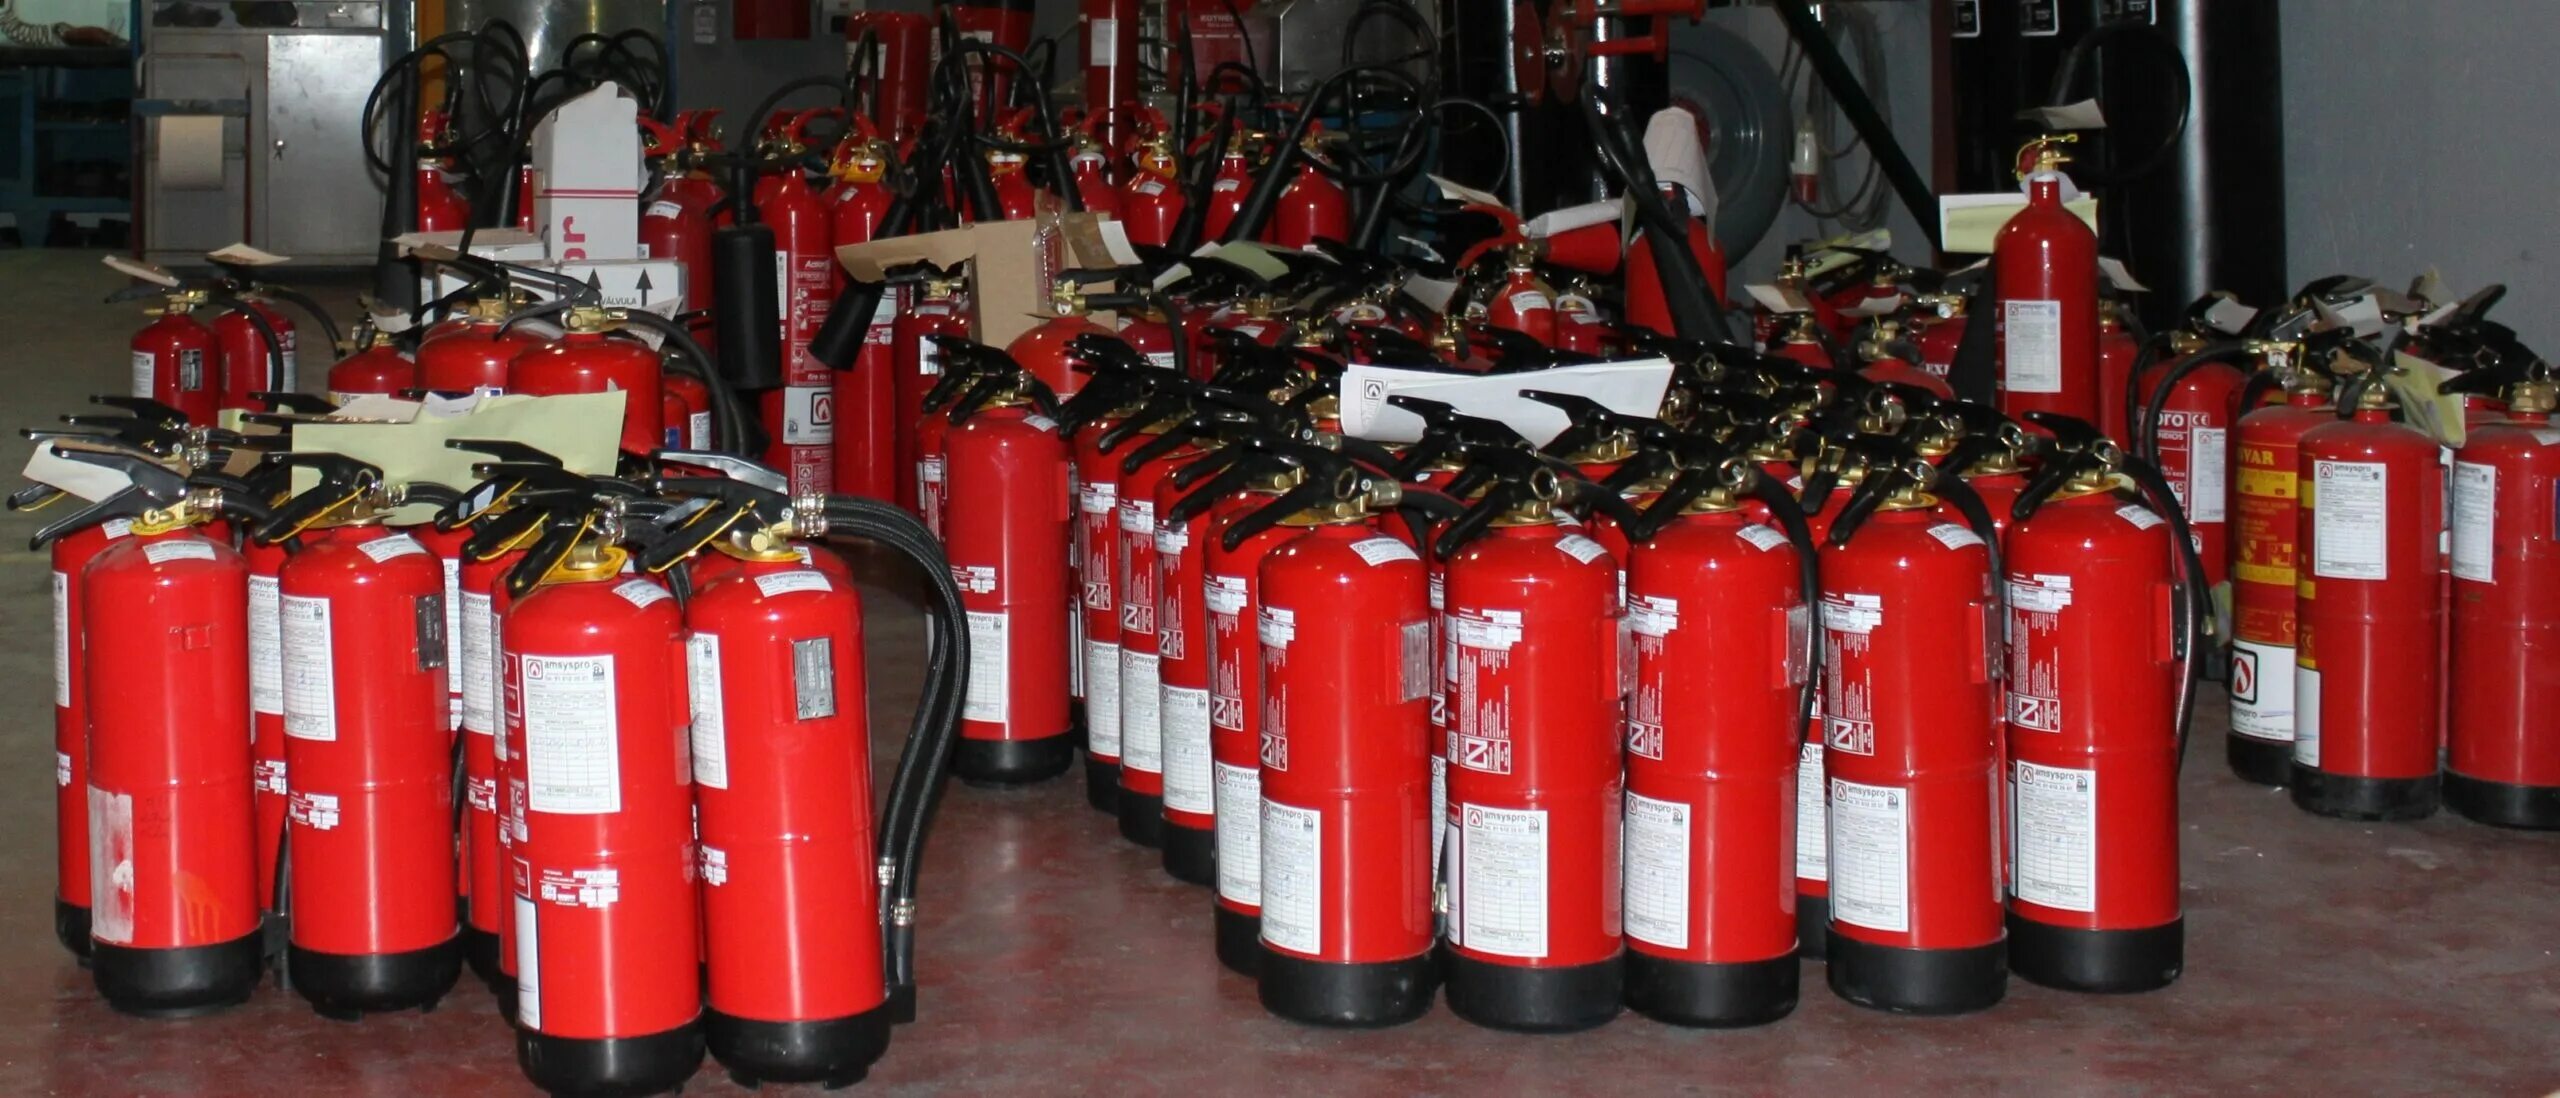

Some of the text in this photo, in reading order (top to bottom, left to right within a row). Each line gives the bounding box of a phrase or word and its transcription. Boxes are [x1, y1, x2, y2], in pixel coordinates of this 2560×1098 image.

[544, 660, 590, 671] amsyspro
[2035, 769, 2075, 780] amsyspro
[1848, 786, 1886, 797] amsyspro
[1484, 811, 1527, 822] amsyspro
